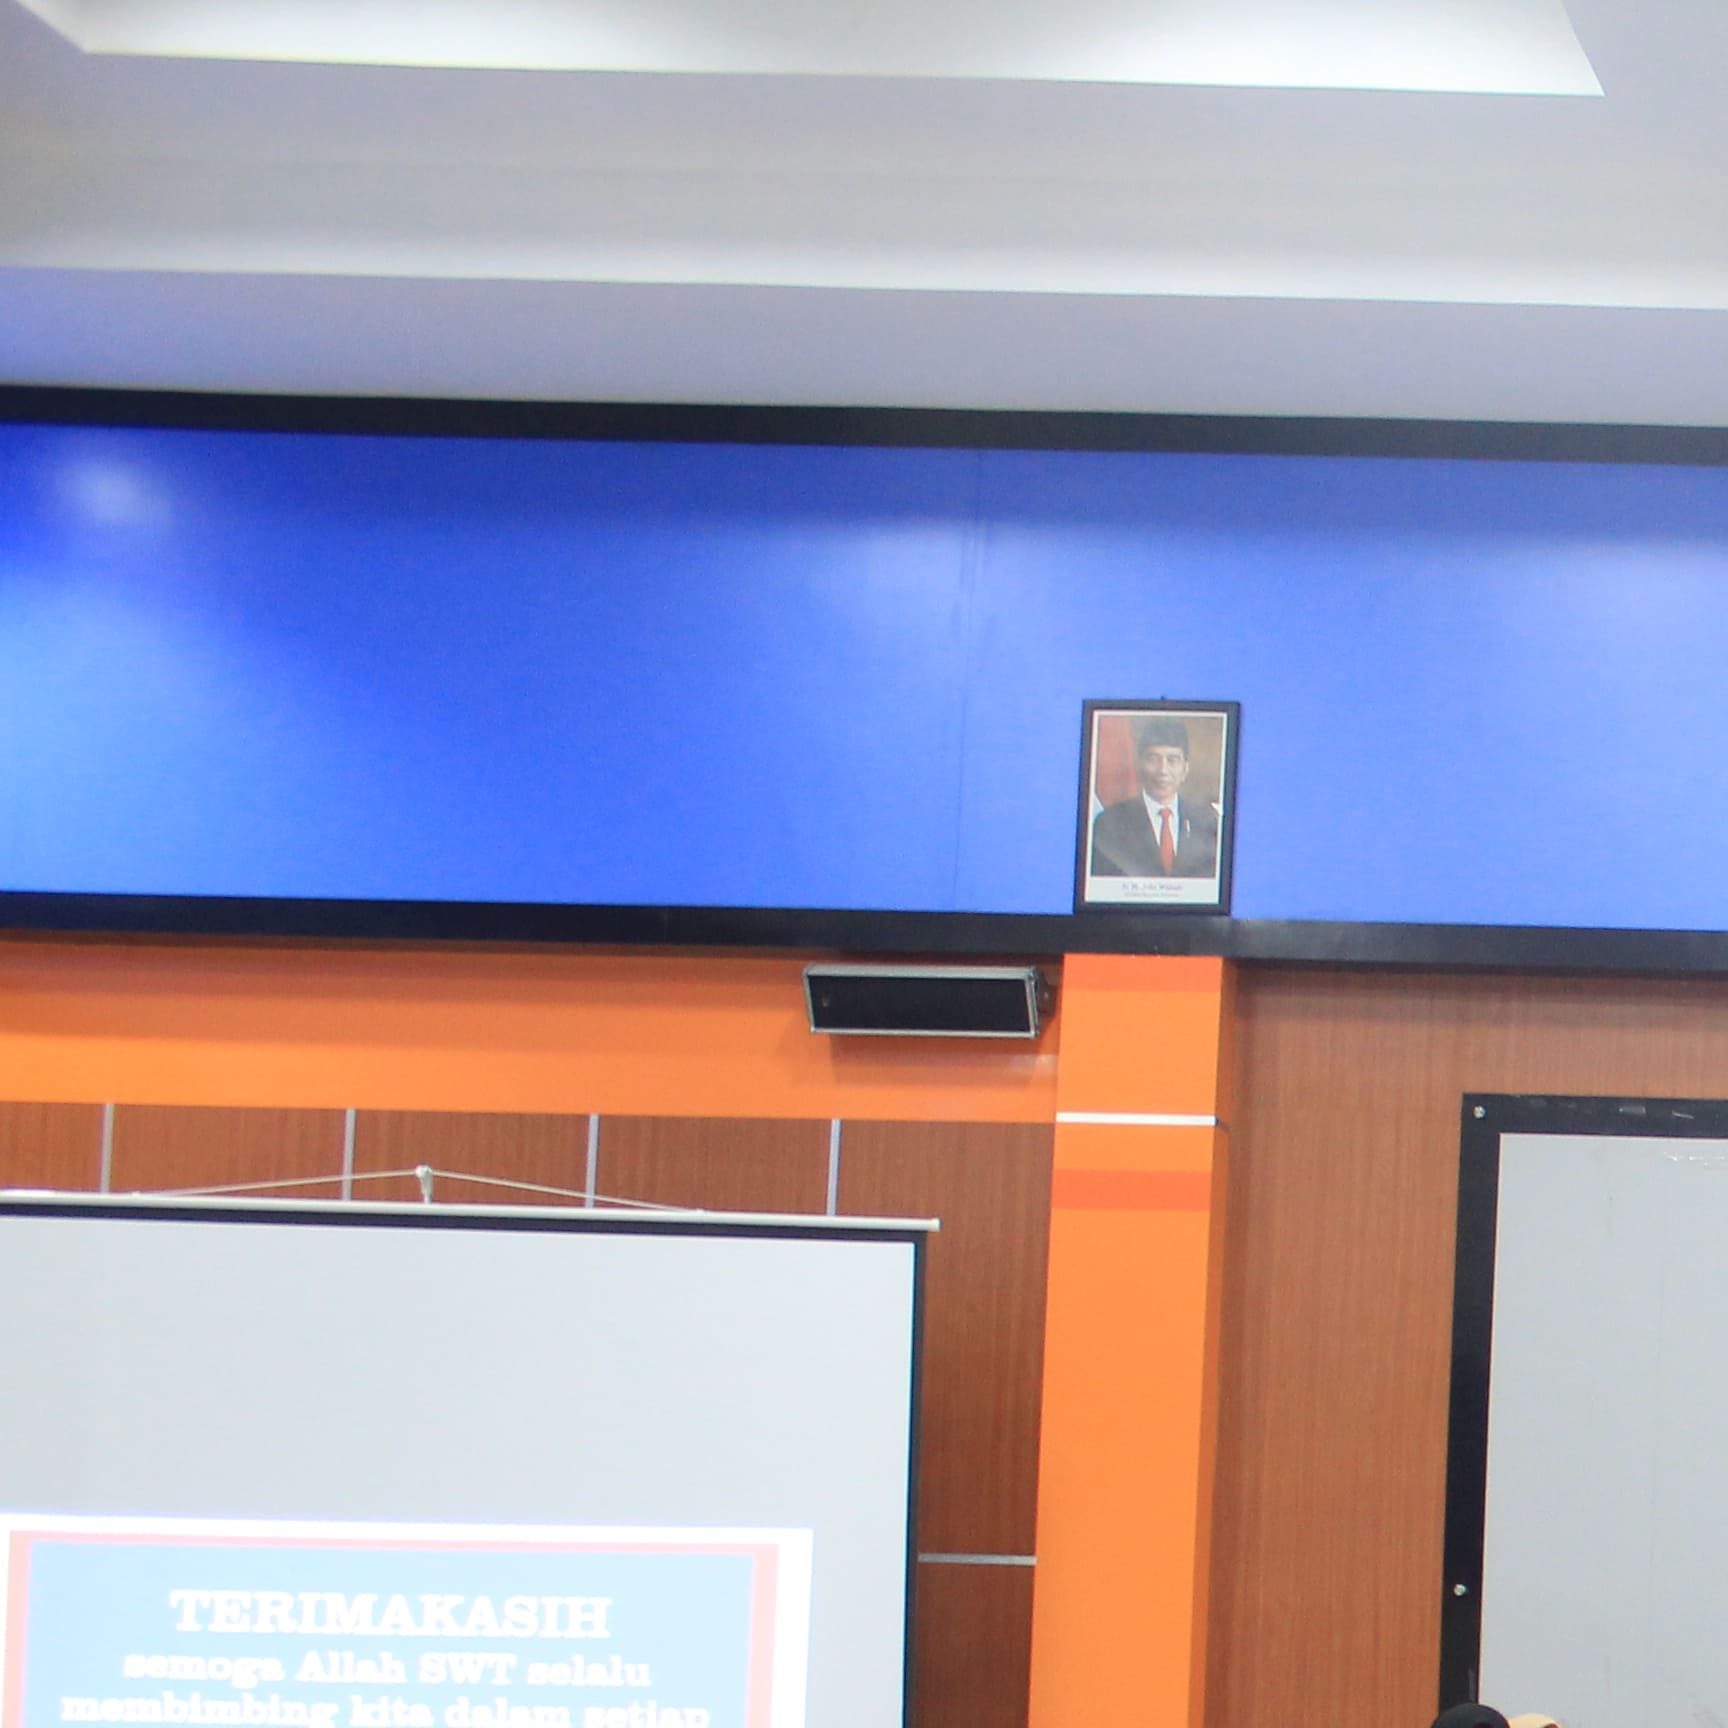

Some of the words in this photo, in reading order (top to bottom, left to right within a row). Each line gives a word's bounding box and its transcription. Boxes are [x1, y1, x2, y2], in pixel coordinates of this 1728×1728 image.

[168, 1588, 613, 1639] TERIMAKASIH
[121, 1654, 286, 1690] semoga
[294, 1650, 408, 1684] Allah
[417, 1651, 518, 1686] SWT
[525, 1653, 652, 1687] selalu
[348, 1694, 435, 1728] kita
